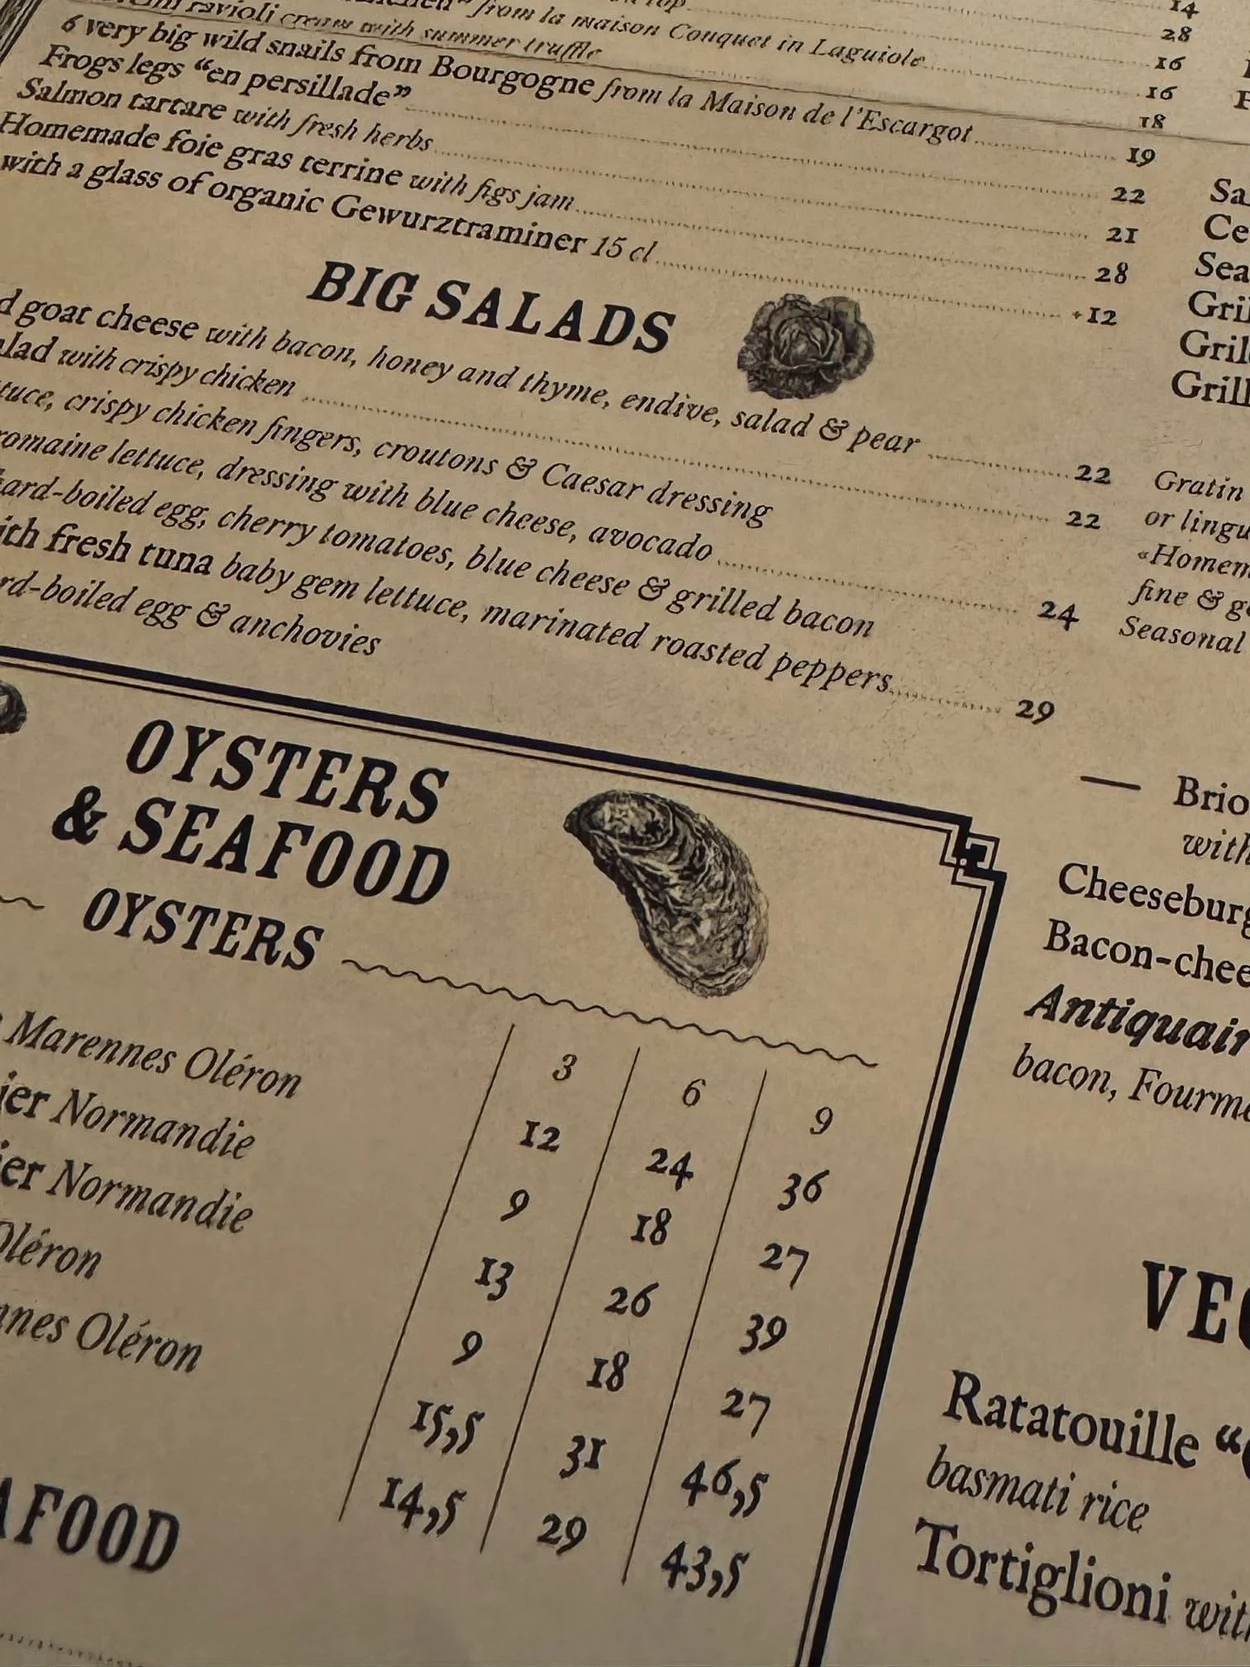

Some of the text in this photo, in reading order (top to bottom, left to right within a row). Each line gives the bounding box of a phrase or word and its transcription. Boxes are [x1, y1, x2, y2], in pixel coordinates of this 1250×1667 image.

[1170, 0, 1199, 19] 14
[17, 78, 1139, 244] Salmon tartare with fresh herbs 21
[39, 44, 124, 79] Frogs
[125, 52, 185, 85] legs
[1111, 187, 1145, 204] 22
[306, 261, 676, 354] BIG SALADS
[15, 301, 1111, 485] goat cheese with bacon, honey and thyme, endive, salad & pear 22
[1155, 471, 1243, 501] Gratin
[126, 719, 449, 824] OYSTERS
[52, 786, 449, 905] & SEAFOOD
[83, 888, 324, 970] OYSTERS
[3, 1011, 301, 1099] Marennes Oléron
[552, 1054, 833, 1134] 3 6 9
[520, 1120, 830, 1211] 12 24 36
[942, 1370, 1199, 1468] Ratatouille
